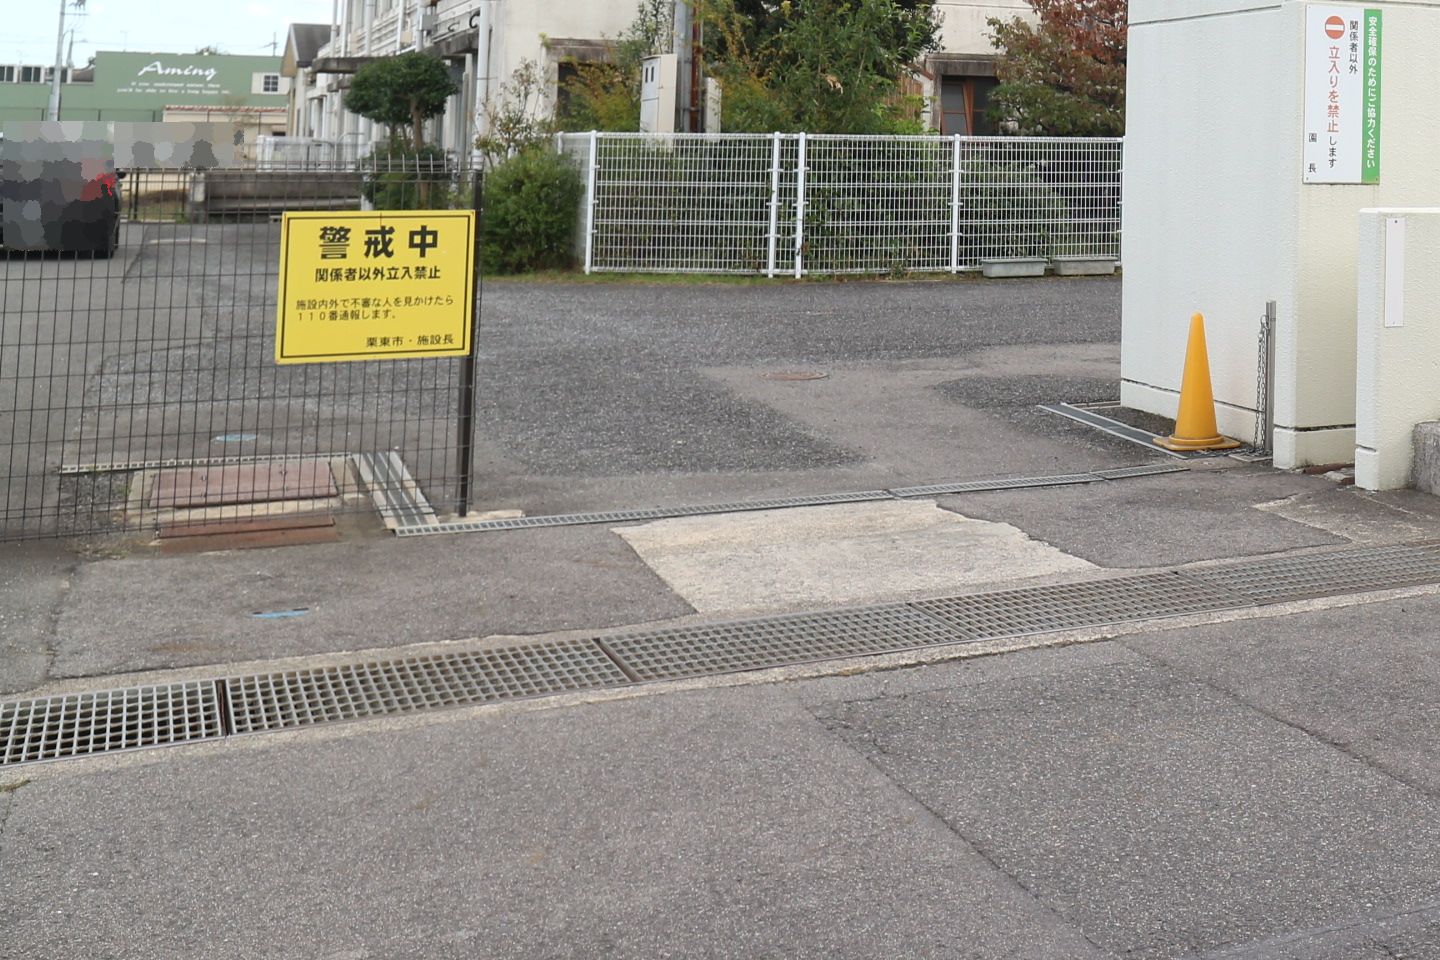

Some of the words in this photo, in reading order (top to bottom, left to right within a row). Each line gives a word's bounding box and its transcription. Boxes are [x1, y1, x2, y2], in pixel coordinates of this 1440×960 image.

[1349, 20, 1359, 74] 関係者以外
[138, 61, 217, 81] Aming
[1366, 16, 1378, 169] 安全確保のためにご協力ください
[1327, 45, 1340, 168] 立入りを禁止します
[318, 225, 439, 260] 警戒中
[315, 265, 441, 283] 関係者以外立入禁止
[296, 294, 454, 310] 施設内外で不審な人を見かけたら
[366, 334, 454, 348] 栗東市・施設長
